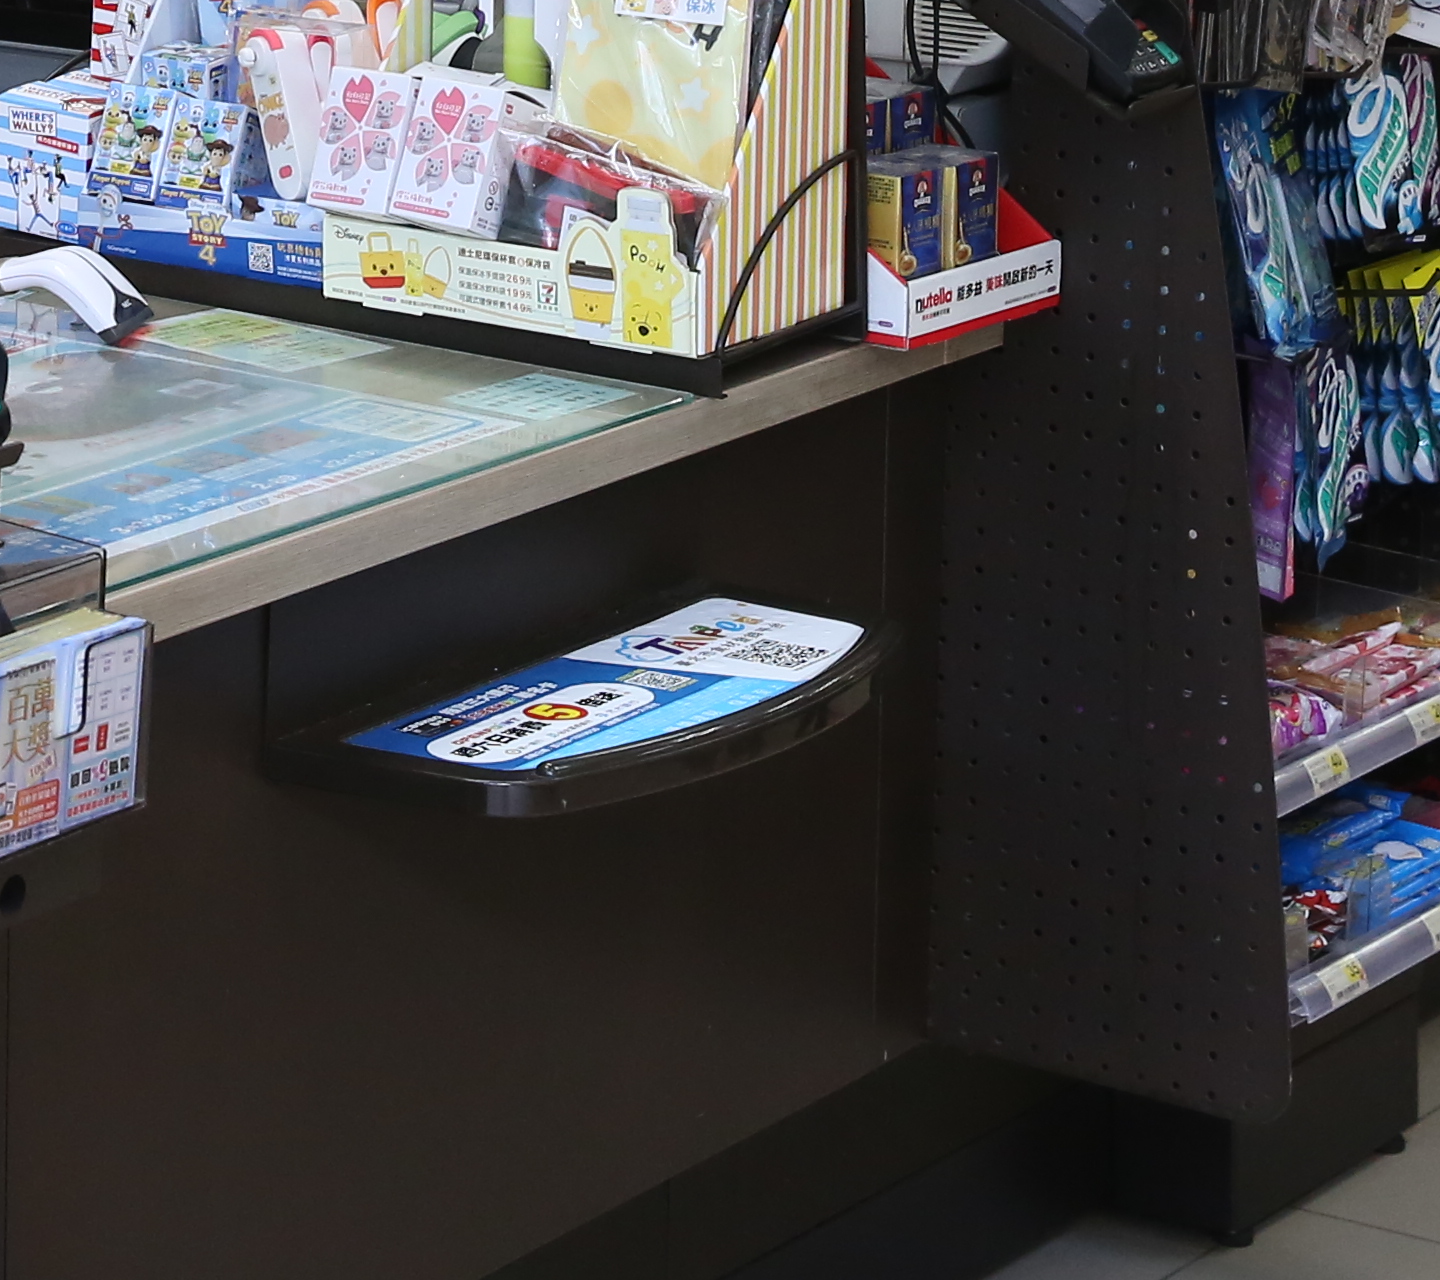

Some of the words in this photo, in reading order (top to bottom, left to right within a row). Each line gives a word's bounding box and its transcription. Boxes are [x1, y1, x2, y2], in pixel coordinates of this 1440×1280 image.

[11, 109, 55, 124] WHERE'S
[12, 121, 54, 134] WALLY?
[188, 211, 228, 234] TOY
[272, 210, 299, 227] TOY
[190, 233, 225, 247] STORY
[199, 246, 216, 265] 4
[525, 257, 552, 270] 保冷袋
